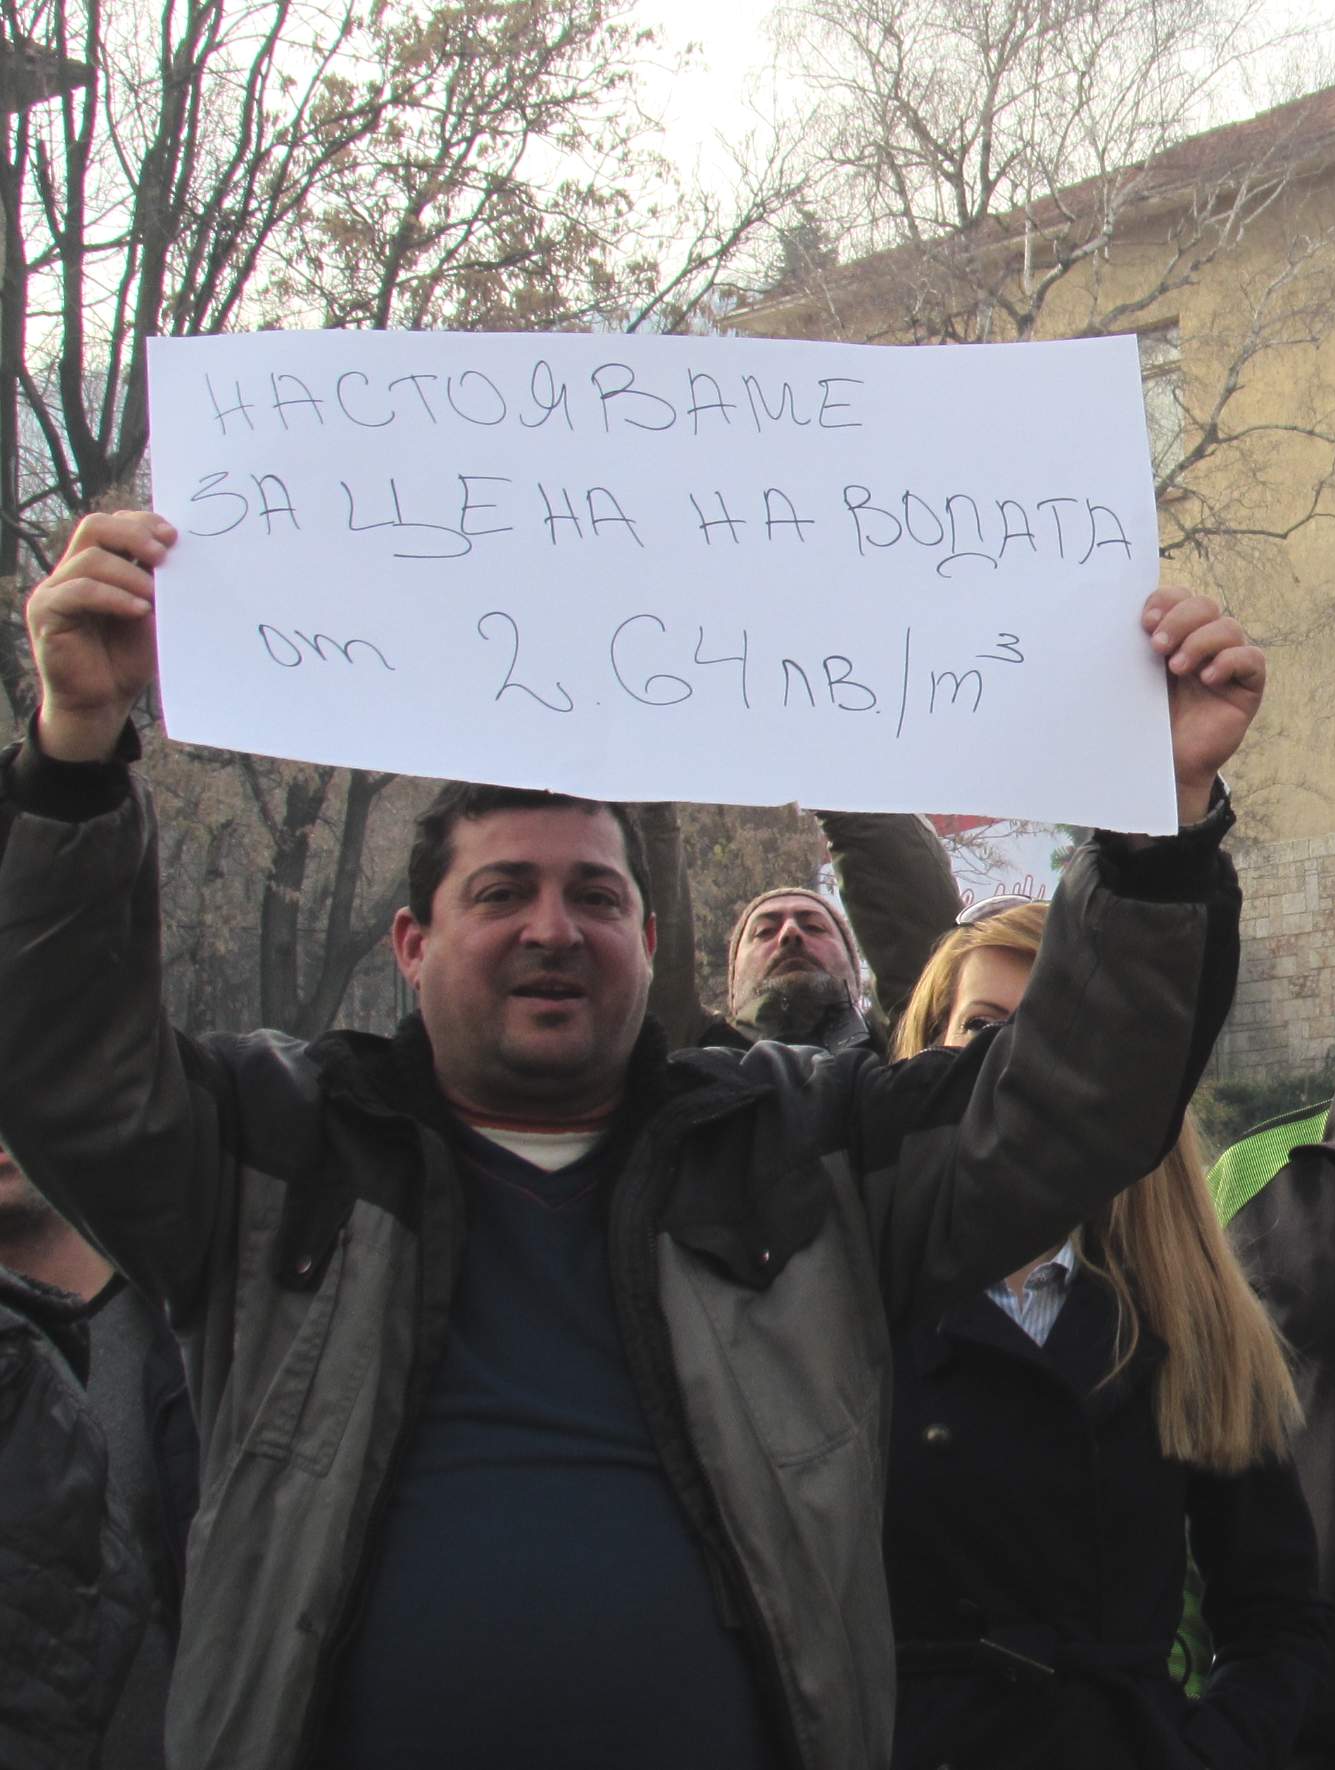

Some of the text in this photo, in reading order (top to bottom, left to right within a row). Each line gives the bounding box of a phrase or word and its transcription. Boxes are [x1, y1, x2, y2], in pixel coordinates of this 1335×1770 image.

[205, 360, 866, 435] НАСТОЯВАМЕ
[189, 472, 1132, 578] ЗА ЦЕНА НА ВОДАТА
